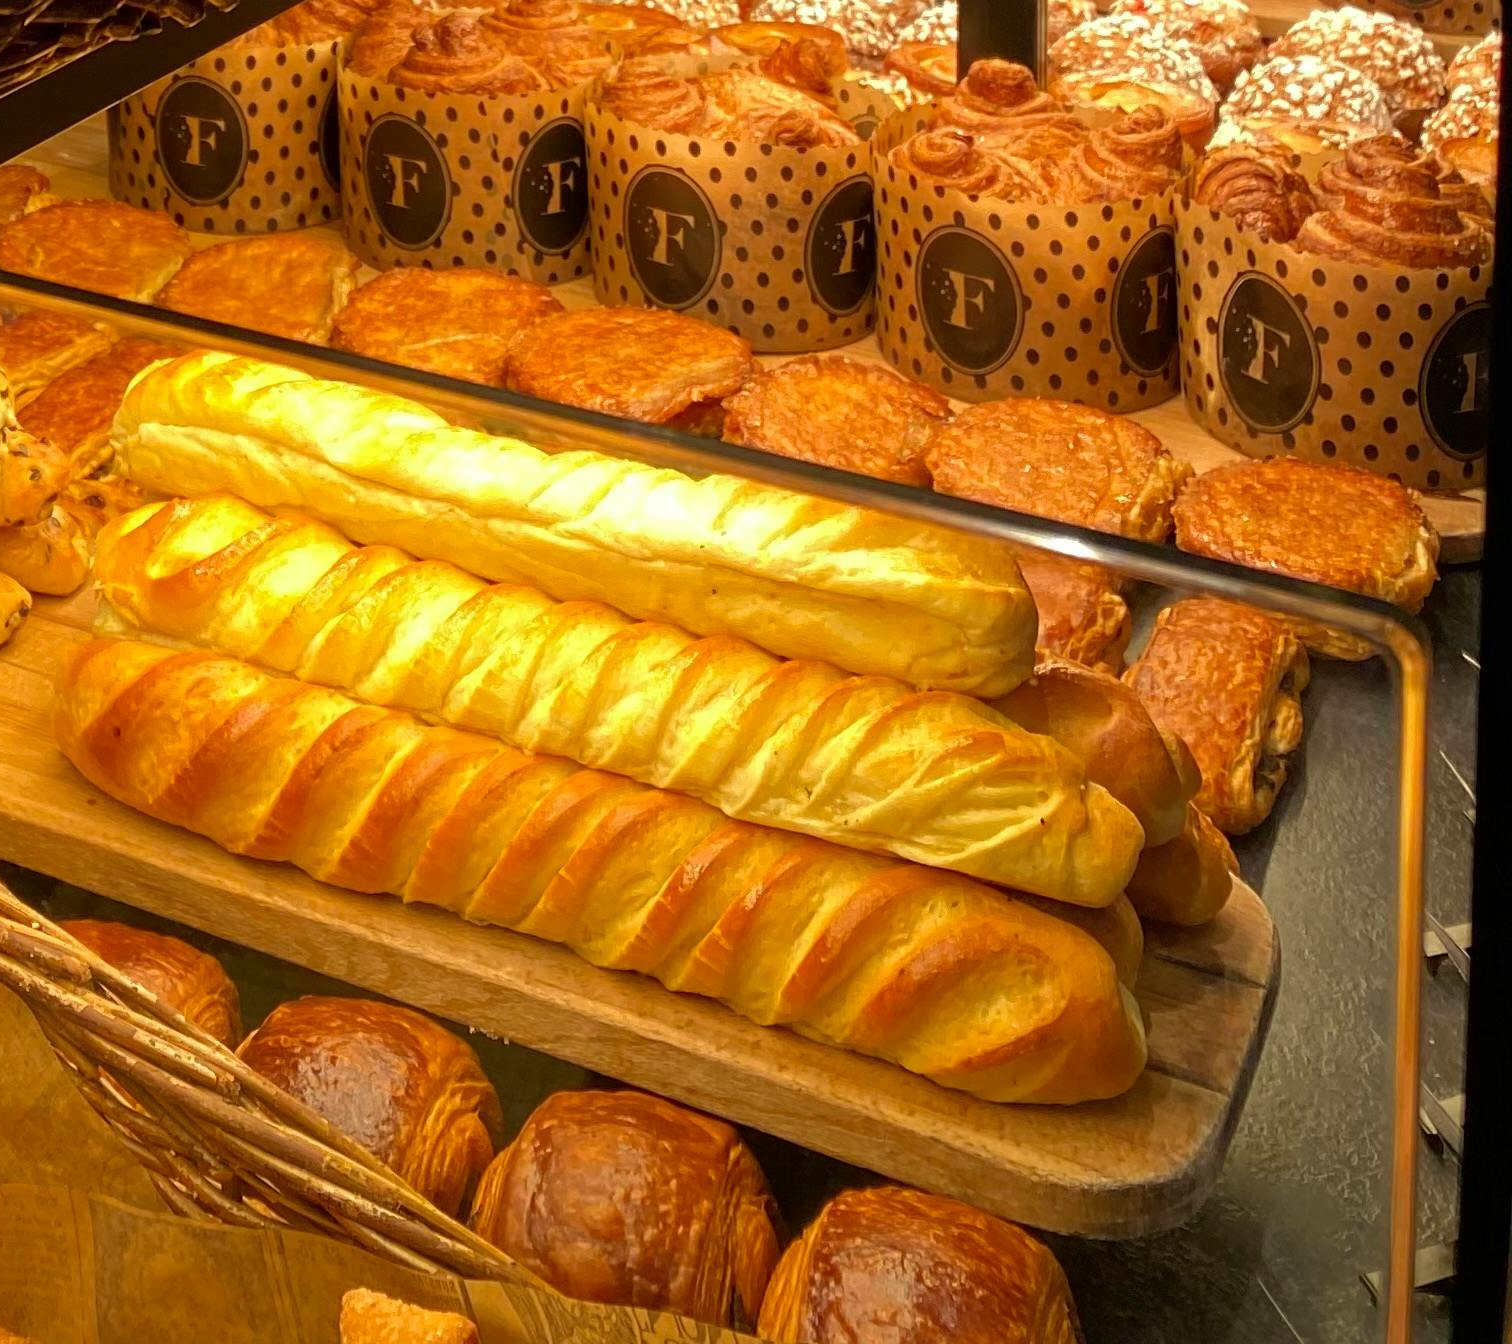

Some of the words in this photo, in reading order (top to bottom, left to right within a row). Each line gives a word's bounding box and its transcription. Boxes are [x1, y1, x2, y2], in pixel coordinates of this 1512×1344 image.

[179, 115, 227, 167] F
[384, 153, 428, 210] F
[540, 156, 582, 216] F
[646, 206, 696, 268] F
[832, 213, 872, 277] F
[941, 267, 996, 331] F
[1140, 266, 1174, 335] F
[1240, 313, 1291, 385] F
